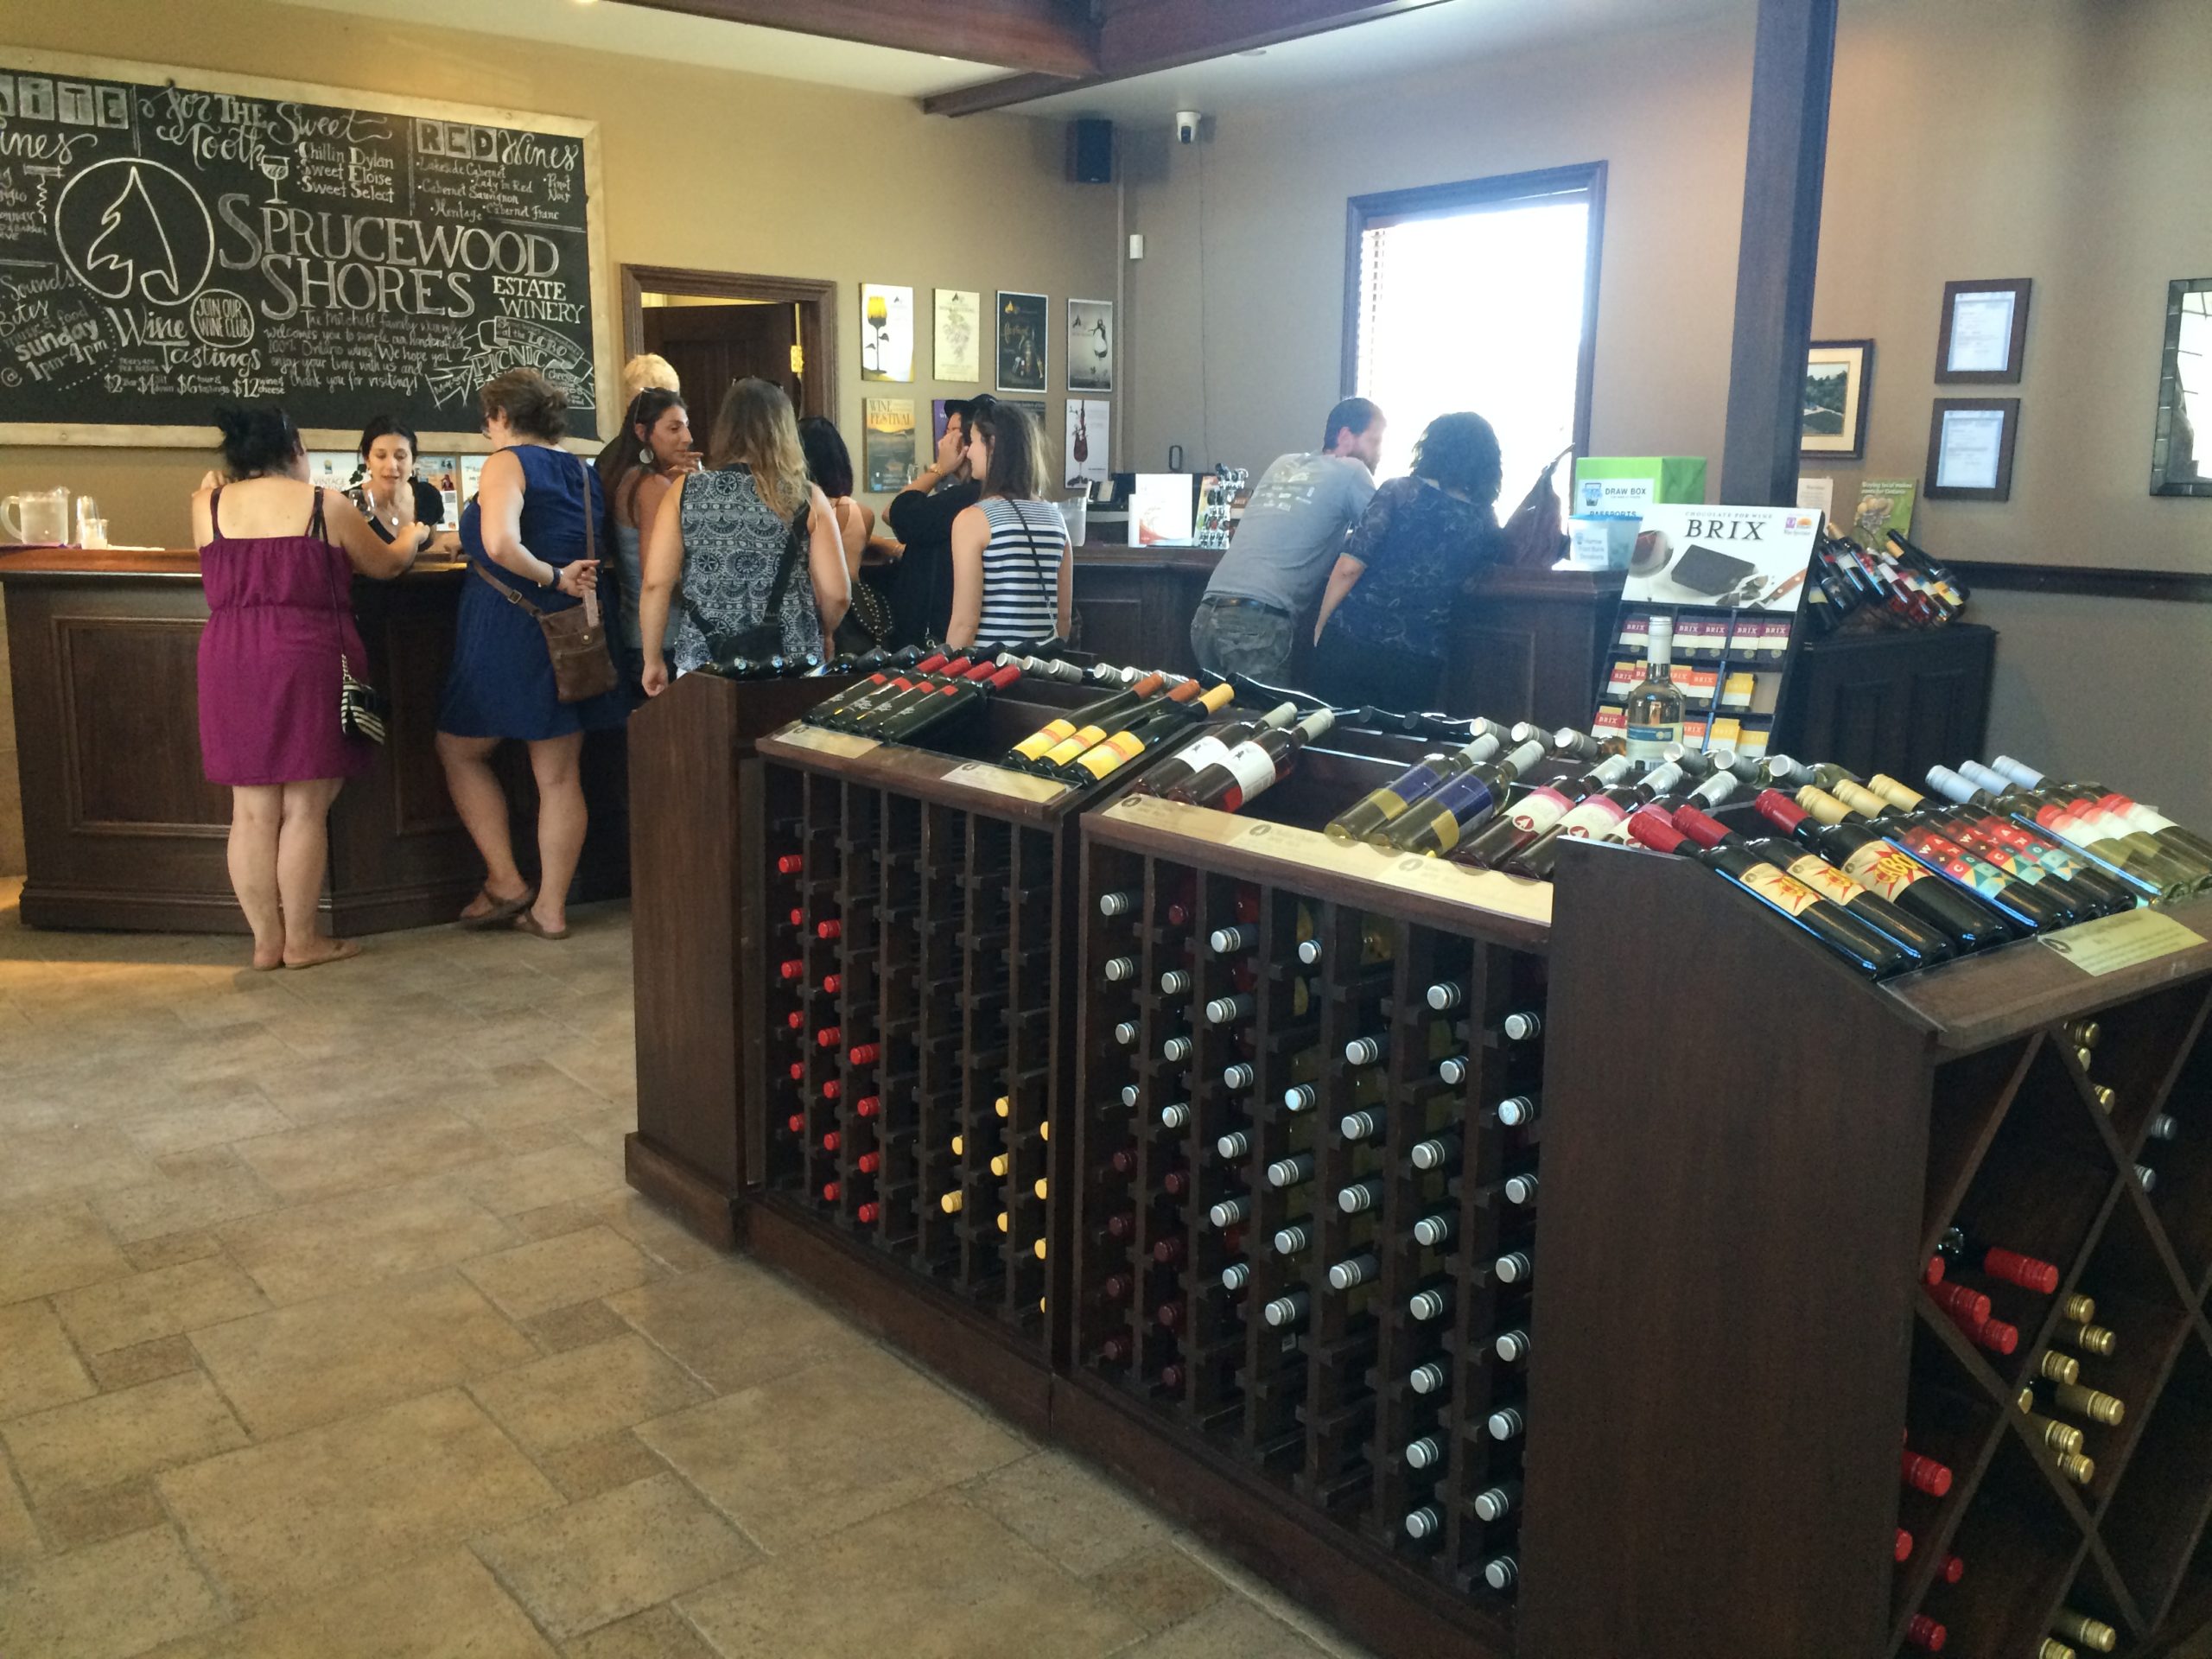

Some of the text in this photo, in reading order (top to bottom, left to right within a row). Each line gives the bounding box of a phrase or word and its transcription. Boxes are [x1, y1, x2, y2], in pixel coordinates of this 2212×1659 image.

[214, 93, 268, 128] THE
[267, 100, 393, 145] Sweet
[156, 123, 267, 171] Tooth
[348, 146, 394, 171] Dylan
[418, 120, 579, 170] RED Wines
[300, 158, 392, 185] Sweet Eloise
[302, 176, 394, 203] Sweet Select
[513, 180, 533, 193] Red
[532, 206, 559, 219] Franc
[219, 194, 559, 276] SPRUCEWOOD
[261, 254, 474, 321] SHORES
[492, 276, 566, 301] ESTATE
[197, 298, 242, 318] JOIN OUR
[499, 297, 584, 324] WINERY
[105, 304, 188, 347] Wine
[197, 317, 251, 339] WINE CLUB
[16, 320, 99, 361] sunday
[469, 345, 547, 377] PICNIC
[232, 378, 259, 397] $12
[869, 400, 892, 412] WINE
[870, 413, 910, 425] FESTIVAL
[1685, 519, 1766, 540] BRIX
